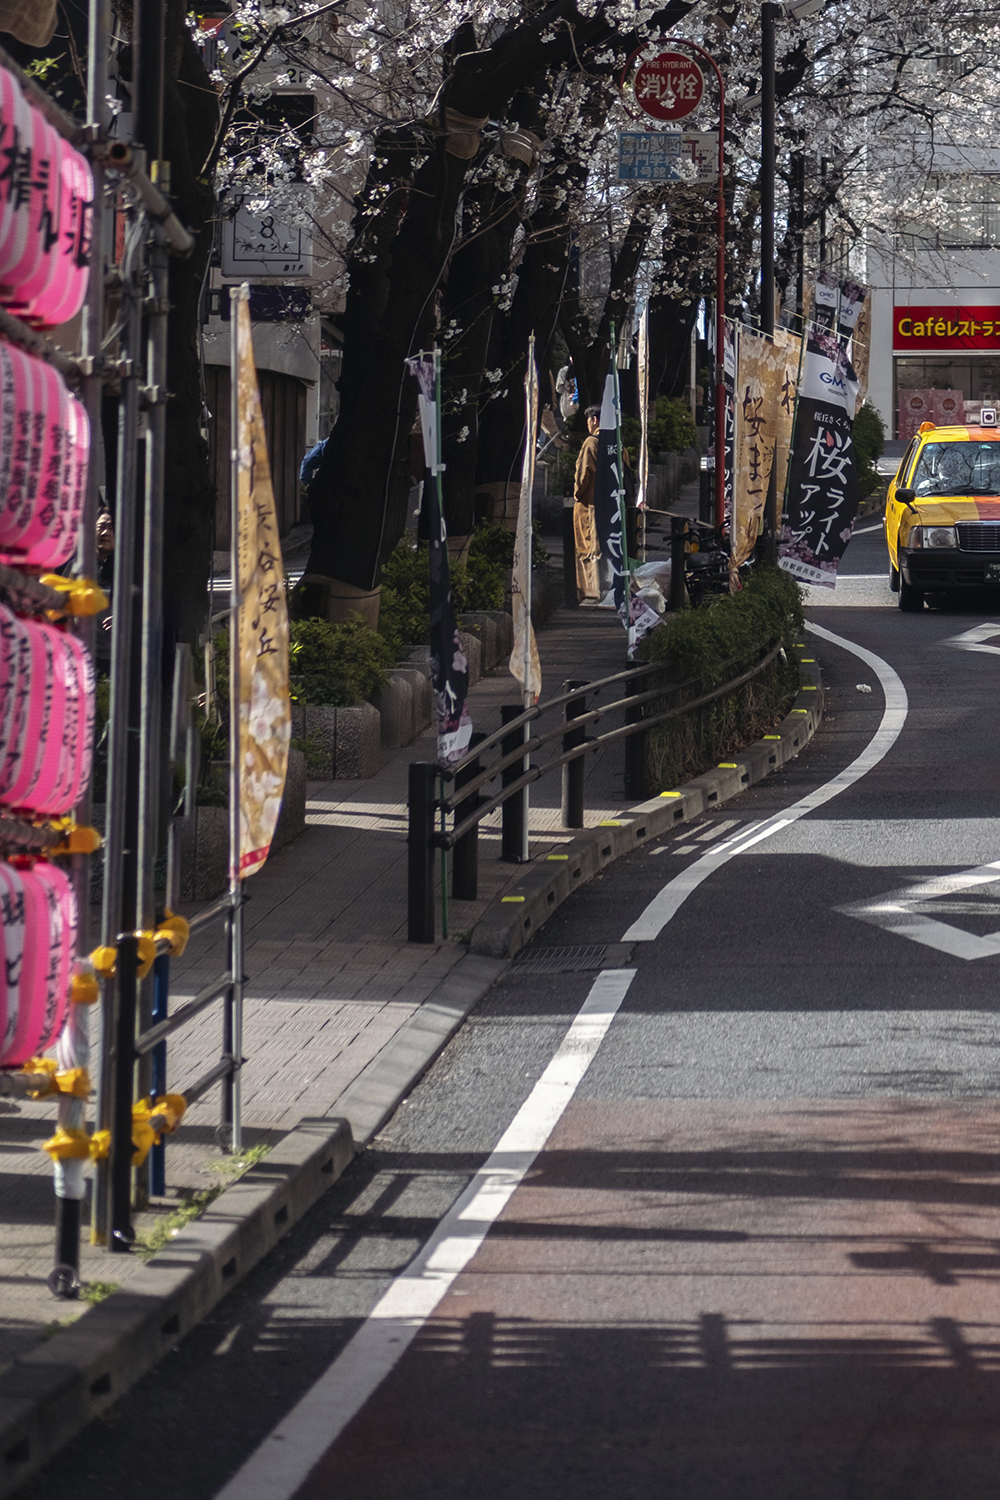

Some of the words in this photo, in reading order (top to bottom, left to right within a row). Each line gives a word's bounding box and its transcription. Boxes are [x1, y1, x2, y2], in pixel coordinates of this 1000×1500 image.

[646, 61, 660, 69] FIRE
[662, 61, 692, 69] HYDRANT
[641, 73, 698, 100] 消火栓
[260, 215, 275, 239] 8
[283, 264, 305, 272] B1F
[803, 426, 853, 485] 桜
[790, 482, 821, 544] アップ
[814, 487, 846, 556] ライト
